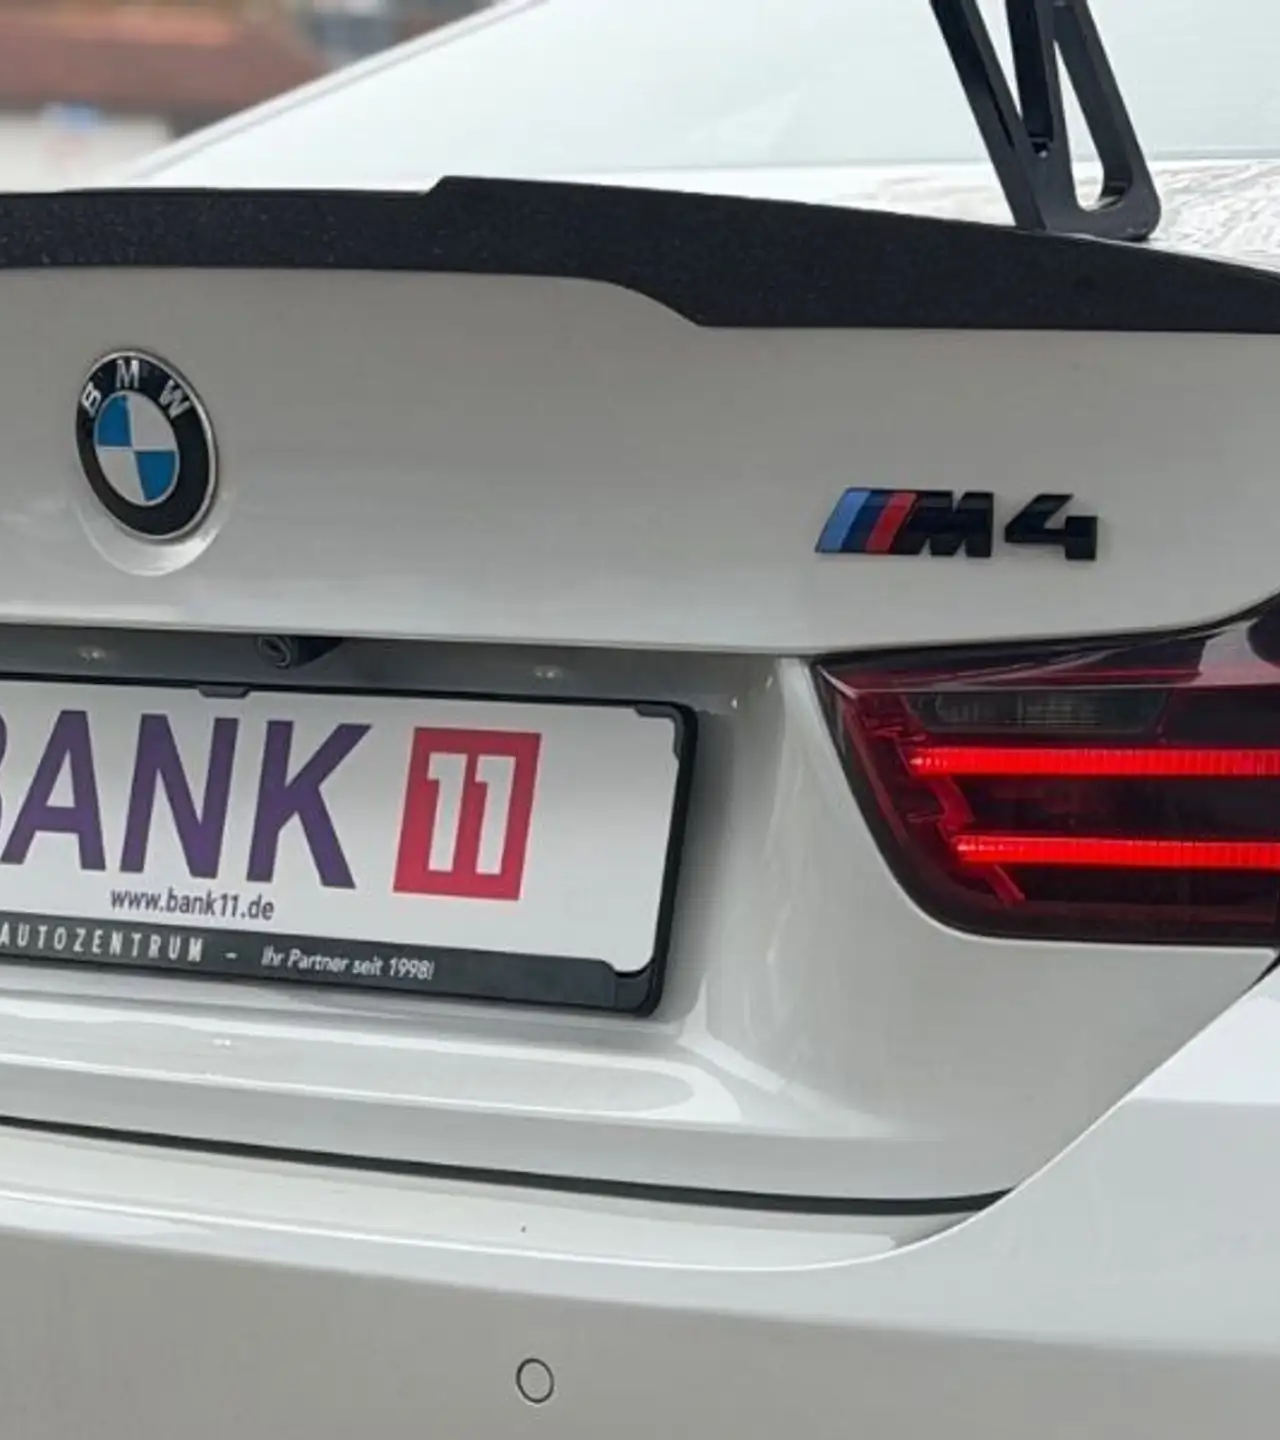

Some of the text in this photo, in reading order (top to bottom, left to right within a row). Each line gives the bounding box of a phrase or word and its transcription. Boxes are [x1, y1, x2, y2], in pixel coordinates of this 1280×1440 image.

[81, 359, 192, 420] BMW
[888, 489, 1099, 561] M4
[426, 752, 517, 877] 11
[110, 887, 275, 921] www.bank11.de
[261, 945, 285, 967] Ihr
[287, 946, 350, 974] Partner
[351, 955, 384, 978] seit
[388, 956, 436, 982] 1998!
